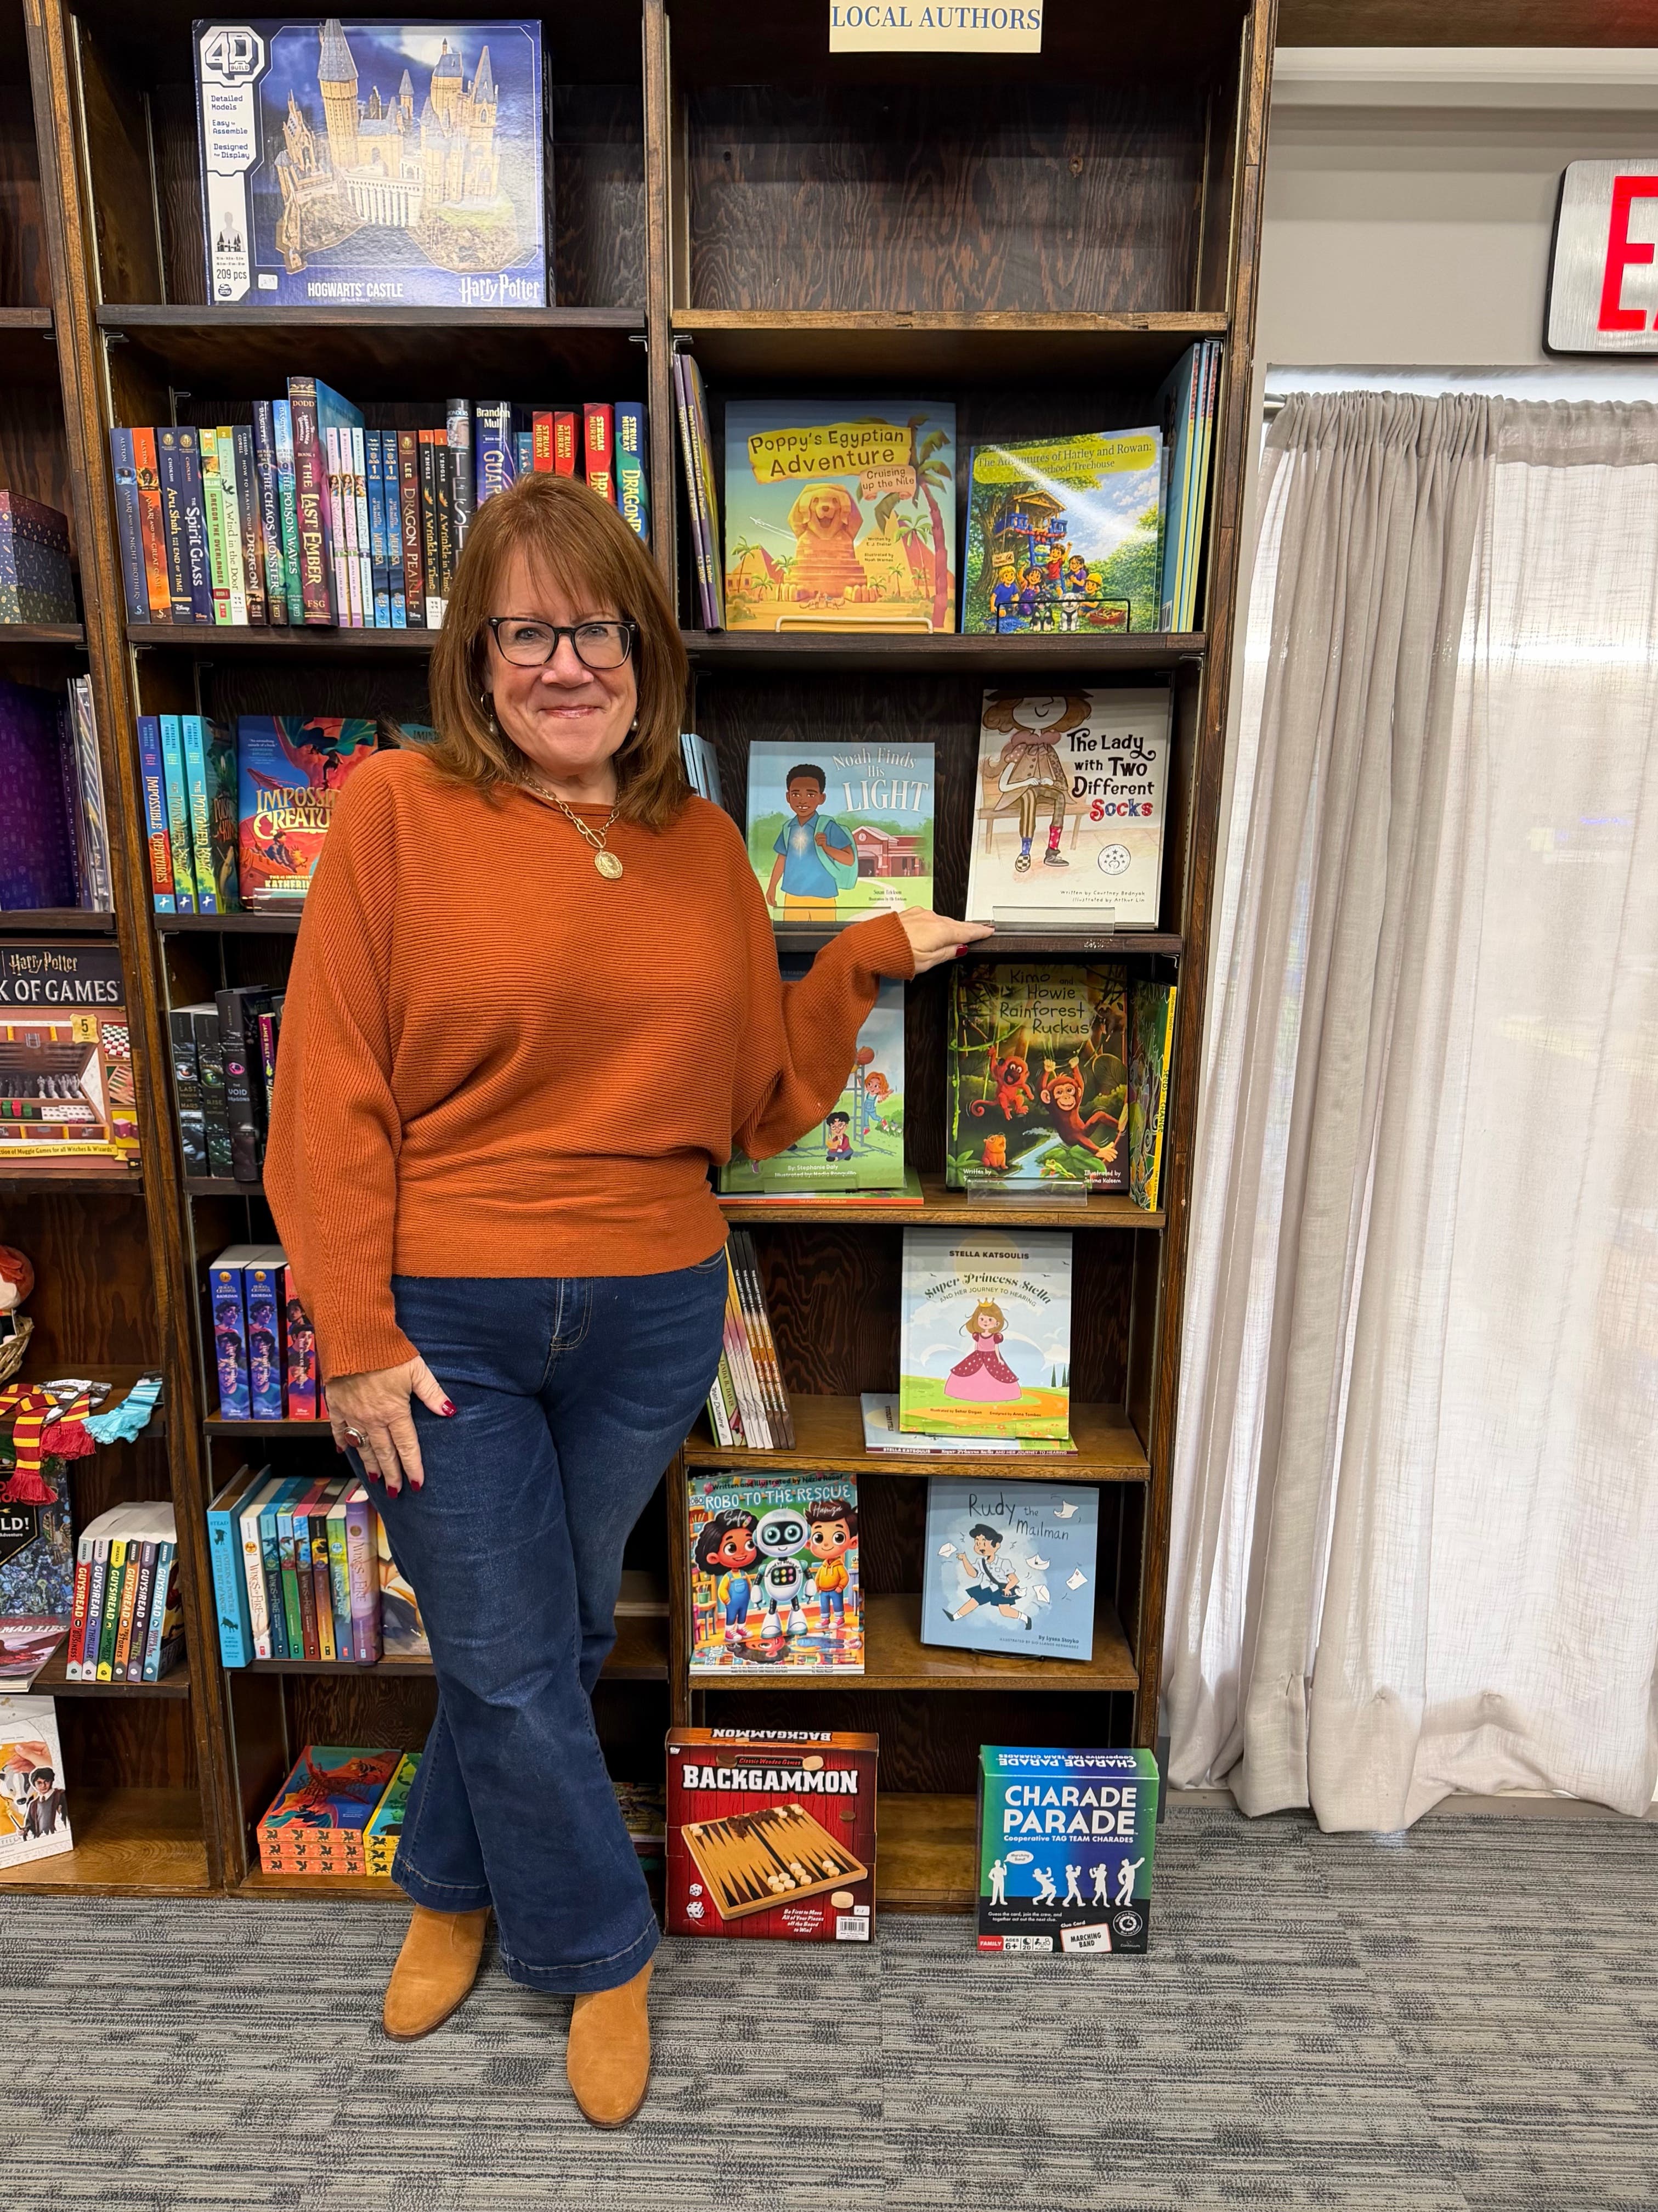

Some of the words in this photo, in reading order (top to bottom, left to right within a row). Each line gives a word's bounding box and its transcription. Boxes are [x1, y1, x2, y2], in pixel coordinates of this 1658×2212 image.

[831, 6, 912, 27] LOCAL
[919, 7, 1040, 30] AUTHORS
[1597, 175, 1658, 332] E
[217, 269, 231, 279] 209
[234, 270, 247, 281] pcs
[308, 283, 361, 297] HOGWARTS
[367, 283, 404, 297] CASTLE
[459, 275, 497, 306] Harry
[499, 273, 540, 300] Potter
[476, 408, 511, 418] Brandon
[629, 416, 637, 452] STRUAN
[750, 432, 822, 454] Poppy's
[829, 429, 903, 449] Egyptian
[770, 448, 895, 477] Adventure
[977, 458, 995, 467] The
[1063, 448, 1095, 461] Harley
[1097, 444, 1114, 455] and
[1117, 442, 1152, 454] Rowan:
[1072, 460, 1115, 471] Treehouse
[244, 479, 249, 488] TO
[263, 472, 273, 490] THE
[302, 462, 313, 488] THE
[863, 482, 875, 490] up
[878, 478, 893, 488] the
[896, 477, 914, 486] Nile
[867, 468, 906, 480] Cruising
[167, 487, 178, 509] Aru
[225, 501, 233, 509] A
[169, 509, 182, 535] Shah
[264, 492, 275, 531] CHAOS
[283, 492, 295, 533] POISON
[301, 493, 320, 528] LAST
[404, 488, 417, 546] DRAGON
[184, 507, 202, 546] Spirit
[426, 520, 438, 556] Wrinkle
[210, 493, 218, 521] GREGOR
[214, 539, 224, 584] OVERLANDER
[389, 532, 400, 566] MEDUSA
[229, 550, 237, 565] the
[246, 532, 259, 589] DRAGON
[267, 532, 280, 593] MONSTER
[286, 536, 298, 574] WAVES
[302, 532, 322, 586] EMBER
[190, 548, 203, 586] GLASS
[407, 553, 419, 597] PEARL
[428, 567, 438, 590] Time
[230, 568, 239, 590] Door
[1067, 727, 1097, 752] The
[1101, 734, 1156, 761] Lady
[833, 748, 872, 771] Noah
[877, 747, 917, 769] Finds
[1074, 759, 1103, 771] with
[1108, 757, 1148, 777] Two
[867, 764, 885, 778] His
[193, 781, 201, 793] THE
[842, 779, 929, 812] LIGHT
[1071, 776, 1155, 798] Different
[145, 776, 161, 830] IMPOSSIBLE
[1089, 798, 1153, 822] Socks
[151, 831, 168, 883] CREATURES
[9, 953, 42, 975] Harry
[43, 951, 78, 976] Potter
[1010, 969, 1050, 984] Kimo
[1059, 977, 1074, 985] and
[15, 980, 42, 1002] OF
[46, 979, 118, 1002] GAMES
[1027, 986, 1076, 1000] Howie
[1000, 1002, 1085, 1019] Rainforest
[82, 1018, 89, 1033] 5
[1032, 1019, 1090, 1035] Ruckus
[228, 1088, 247, 1096] VOID
[983, 1251, 1029, 1260] KATSOULIS
[925, 1278, 959, 1299] Super
[963, 1272, 1018, 1286] Princess
[1020, 1280, 1051, 1305] Stella
[940, 1294, 953, 1303] AND
[1010, 1290, 1037, 1307] HEARING
[705, 1494, 739, 1509] ROBO
[743, 1492, 761, 1506] TO
[765, 1489, 793, 1503] THE
[797, 1485, 851, 1502] RESCUE
[713, 1482, 739, 1491] Written
[969, 1492, 1016, 1525] Rudy
[1024, 1506, 1039, 1517] the
[1016, 1519, 1069, 1541] Mailman
[1, 1625, 33, 1633] MAD
[37, 1625, 67, 1633] LIBS
[712, 1729, 831, 1741] BACKGAMMON
[999, 1758, 1059, 1767] PARADE
[1064, 1759, 1136, 1768] CHARADE
[682, 1764, 858, 1794] BACKGAMMON
[1005, 1785, 1137, 1808] CHARADE
[1003, 1809, 1135, 1835] PARADE
[1004, 1835, 1050, 1843] Cooperative
[1071, 1932, 1101, 1943] MARCHING
[1079, 1940, 1095, 1948] BAND
